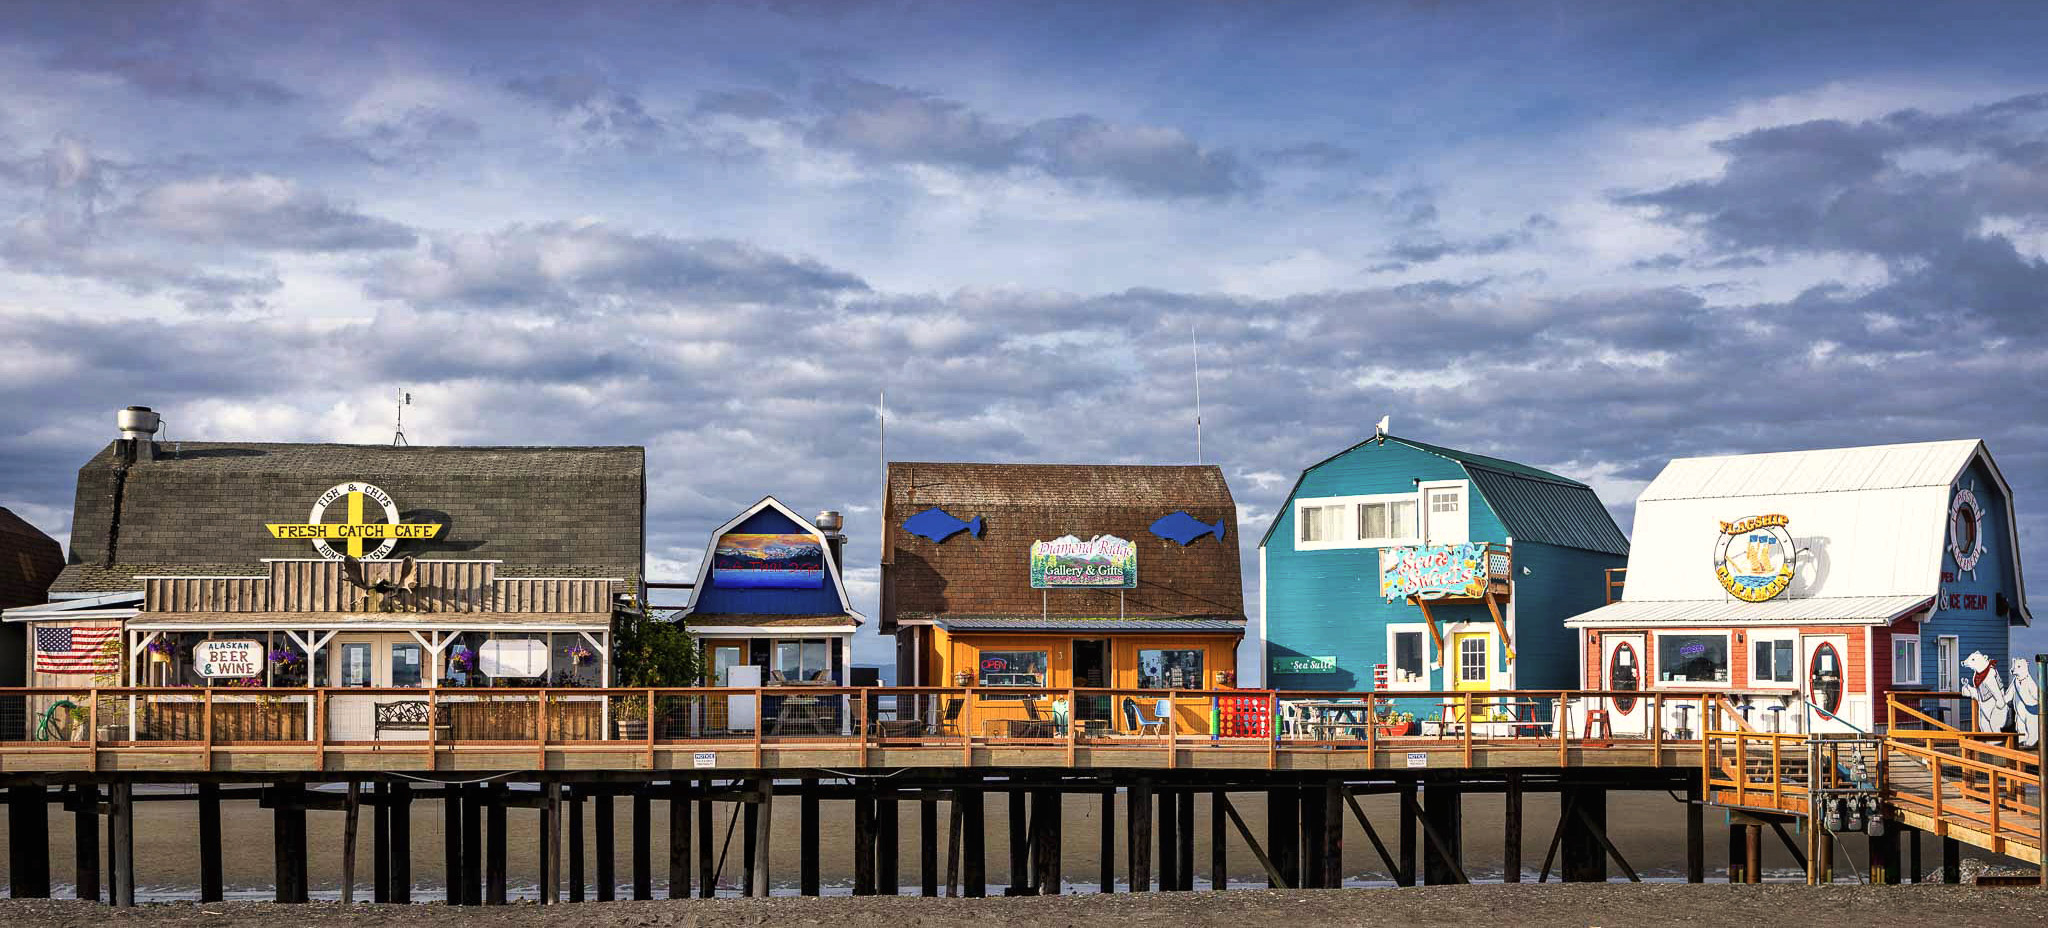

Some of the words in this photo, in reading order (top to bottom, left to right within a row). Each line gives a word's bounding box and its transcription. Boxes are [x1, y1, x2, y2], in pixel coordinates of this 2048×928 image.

[318, 488, 340, 508] FISH
[348, 483, 357, 492] &
[364, 485, 392, 508] CHIPS
[278, 525, 327, 537] FRESH
[338, 525, 384, 537] CATCH
[395, 525, 433, 537] CAFE
[1719, 513, 1789, 535] FLAGSHIP
[359, 544, 391, 560] ASKA
[1038, 534, 1099, 556] Diamond
[1098, 540, 1132, 562] Ridge
[1398, 549, 1432, 576] Sea
[1045, 565, 1083, 577] Gallery
[1086, 565, 1096, 575] &
[1098, 565, 1123, 575] Gifts
[1403, 557, 1472, 593] Sweets
[1716, 563, 1795, 602] CREAMERY
[1940, 587, 1949, 611] &
[1949, 594, 1961, 609] ICE
[1963, 594, 1988, 610] CREAM
[208, 642, 249, 650] ALASKAN
[210, 651, 248, 662] BEER
[981, 659, 1007, 670] OPEN
[1294, 660, 1309, 669] Sea
[204, 663, 214, 674] &
[219, 663, 254, 674] WINE
